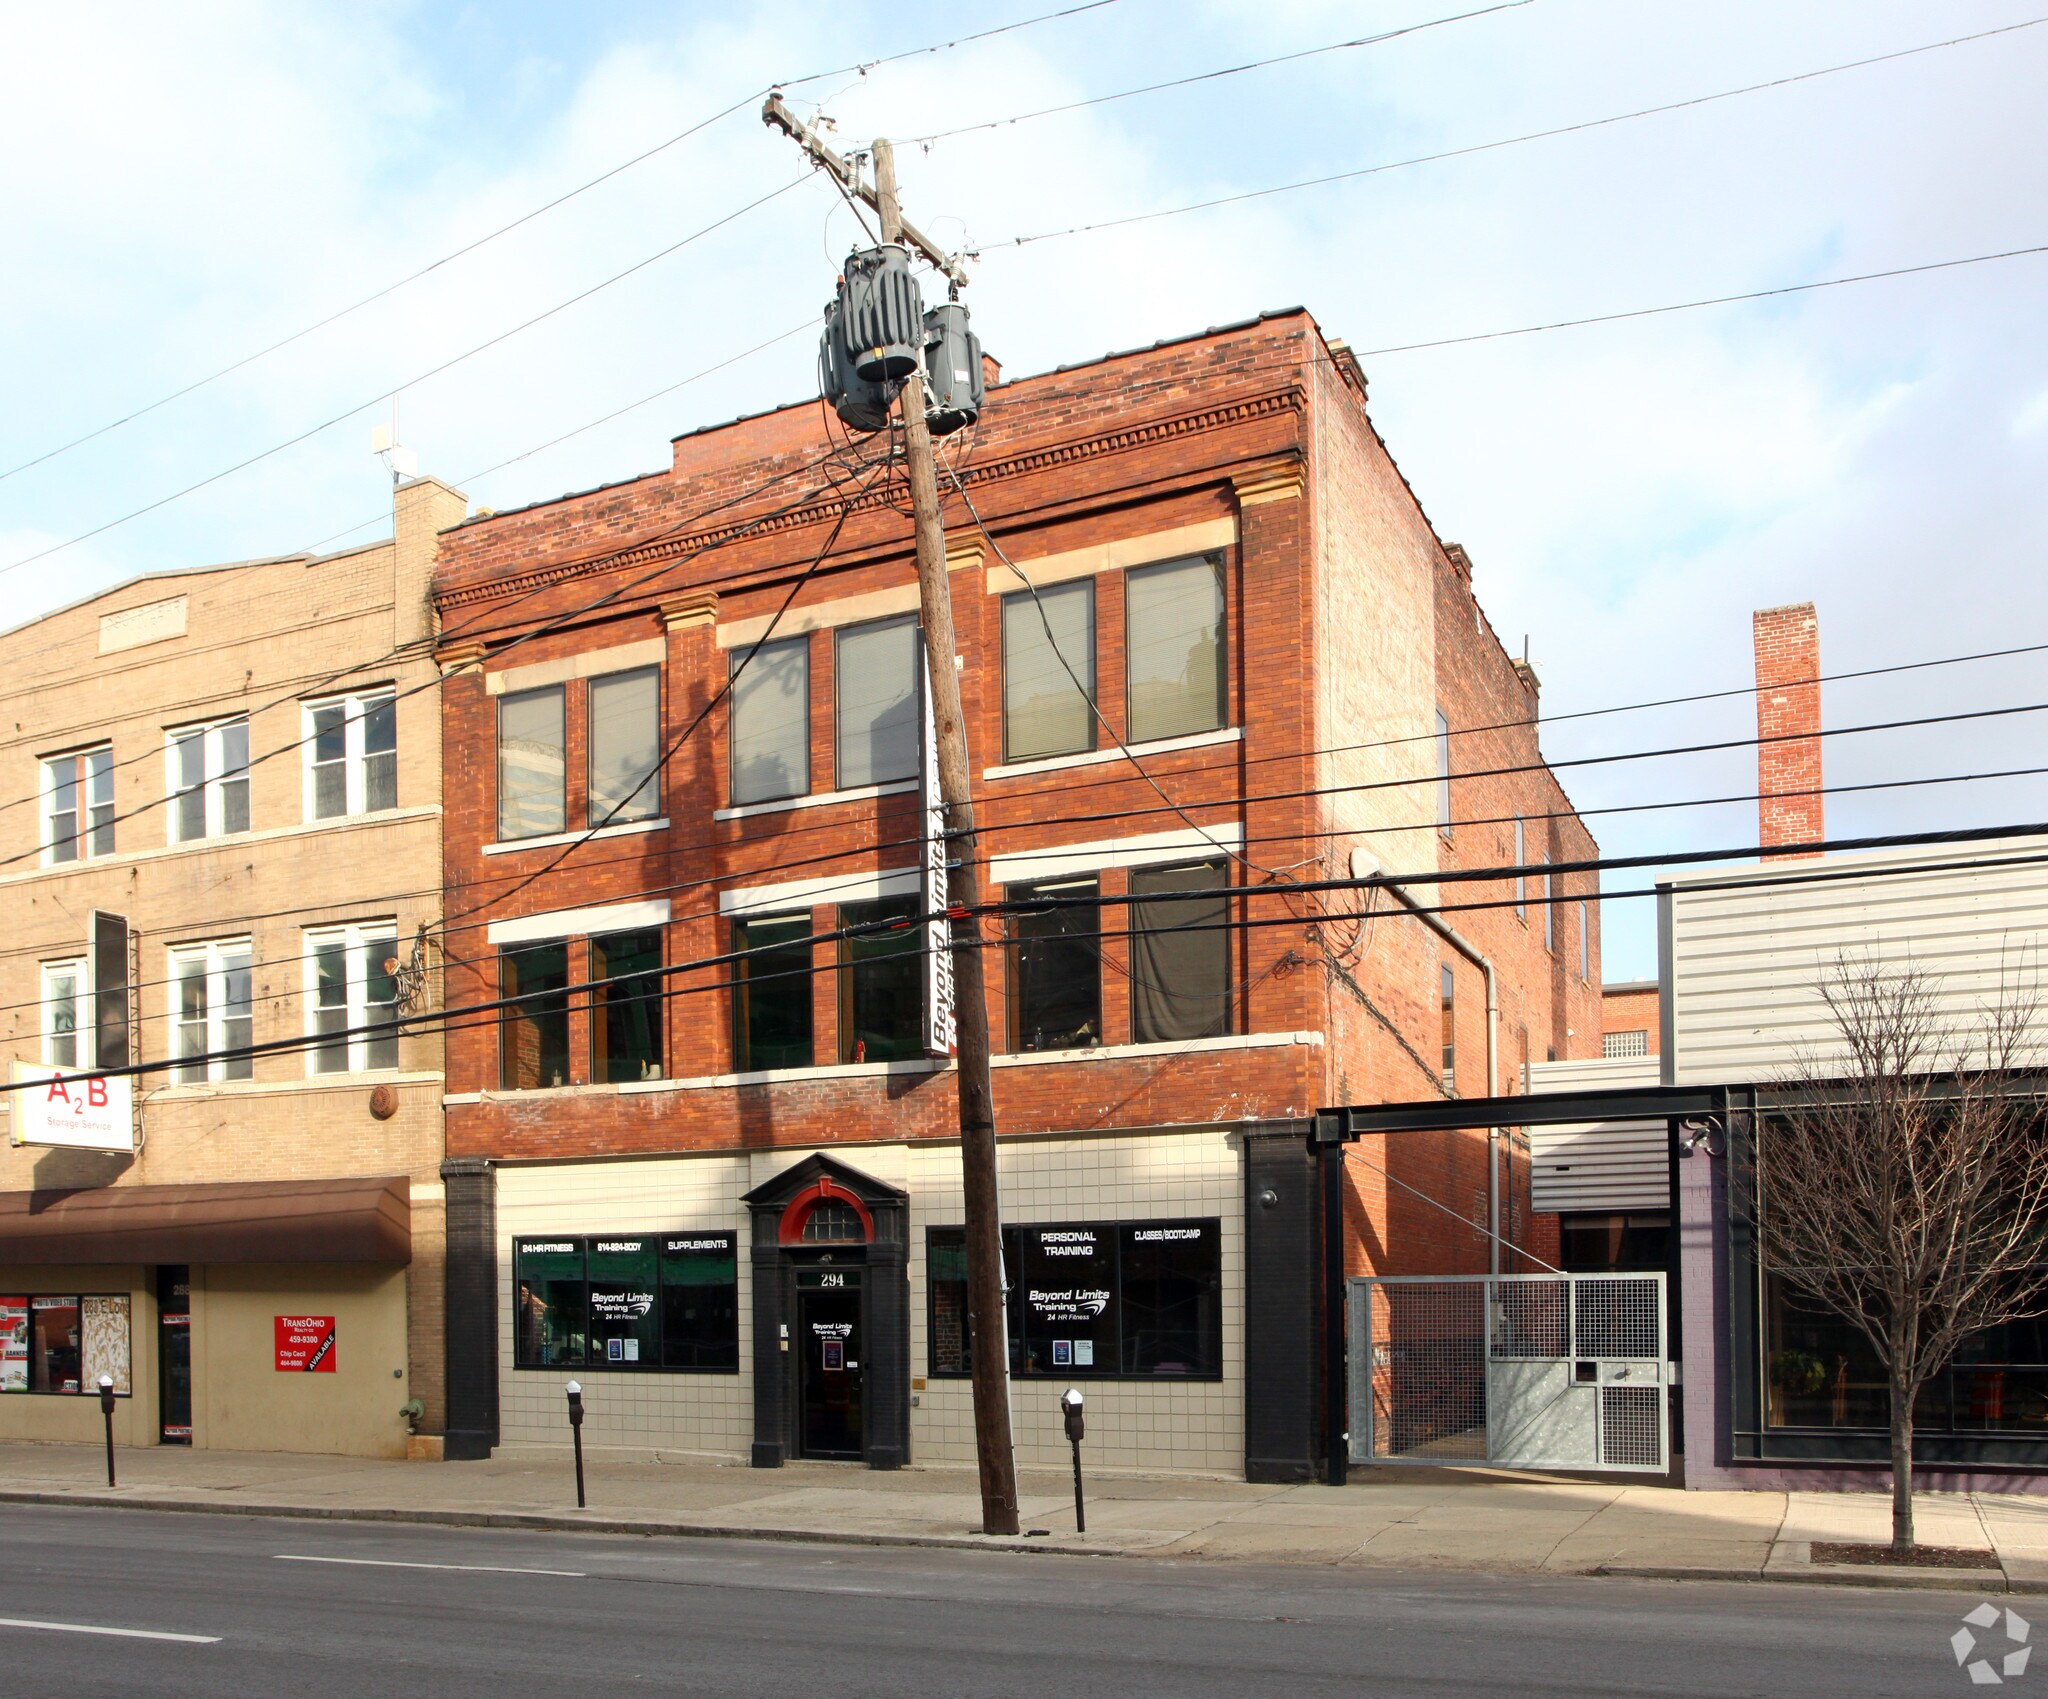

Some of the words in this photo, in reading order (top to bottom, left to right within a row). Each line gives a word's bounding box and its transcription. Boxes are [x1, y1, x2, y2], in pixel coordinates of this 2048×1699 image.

[932, 929, 950, 1047] Beyond
[47, 1116, 78, 1129] Storage
[81, 1119, 112, 1131] Service
[1041, 1231, 1096, 1242] PERSONAL
[1134, 1228, 1201, 1241] CLASSES/BOOTCAMP
[533, 1244, 543, 1252] HR
[544, 1243, 574, 1252] FITNESS
[668, 1239, 728, 1250] SUPPLEMENTS
[1044, 1246, 1093, 1256] TRAINING
[821, 1273, 844, 1286] 294
[592, 1292, 625, 1304] Beyond
[626, 1292, 654, 1302] Limits
[1029, 1290, 1072, 1303] Beyond
[1075, 1289, 1110, 1300] Limits
[594, 1304, 629, 1312] Training
[1033, 1303, 1077, 1312] Training
[289, 1336, 318, 1344] 459-9300
[310, 1334, 334, 1370] AVAILABLE
